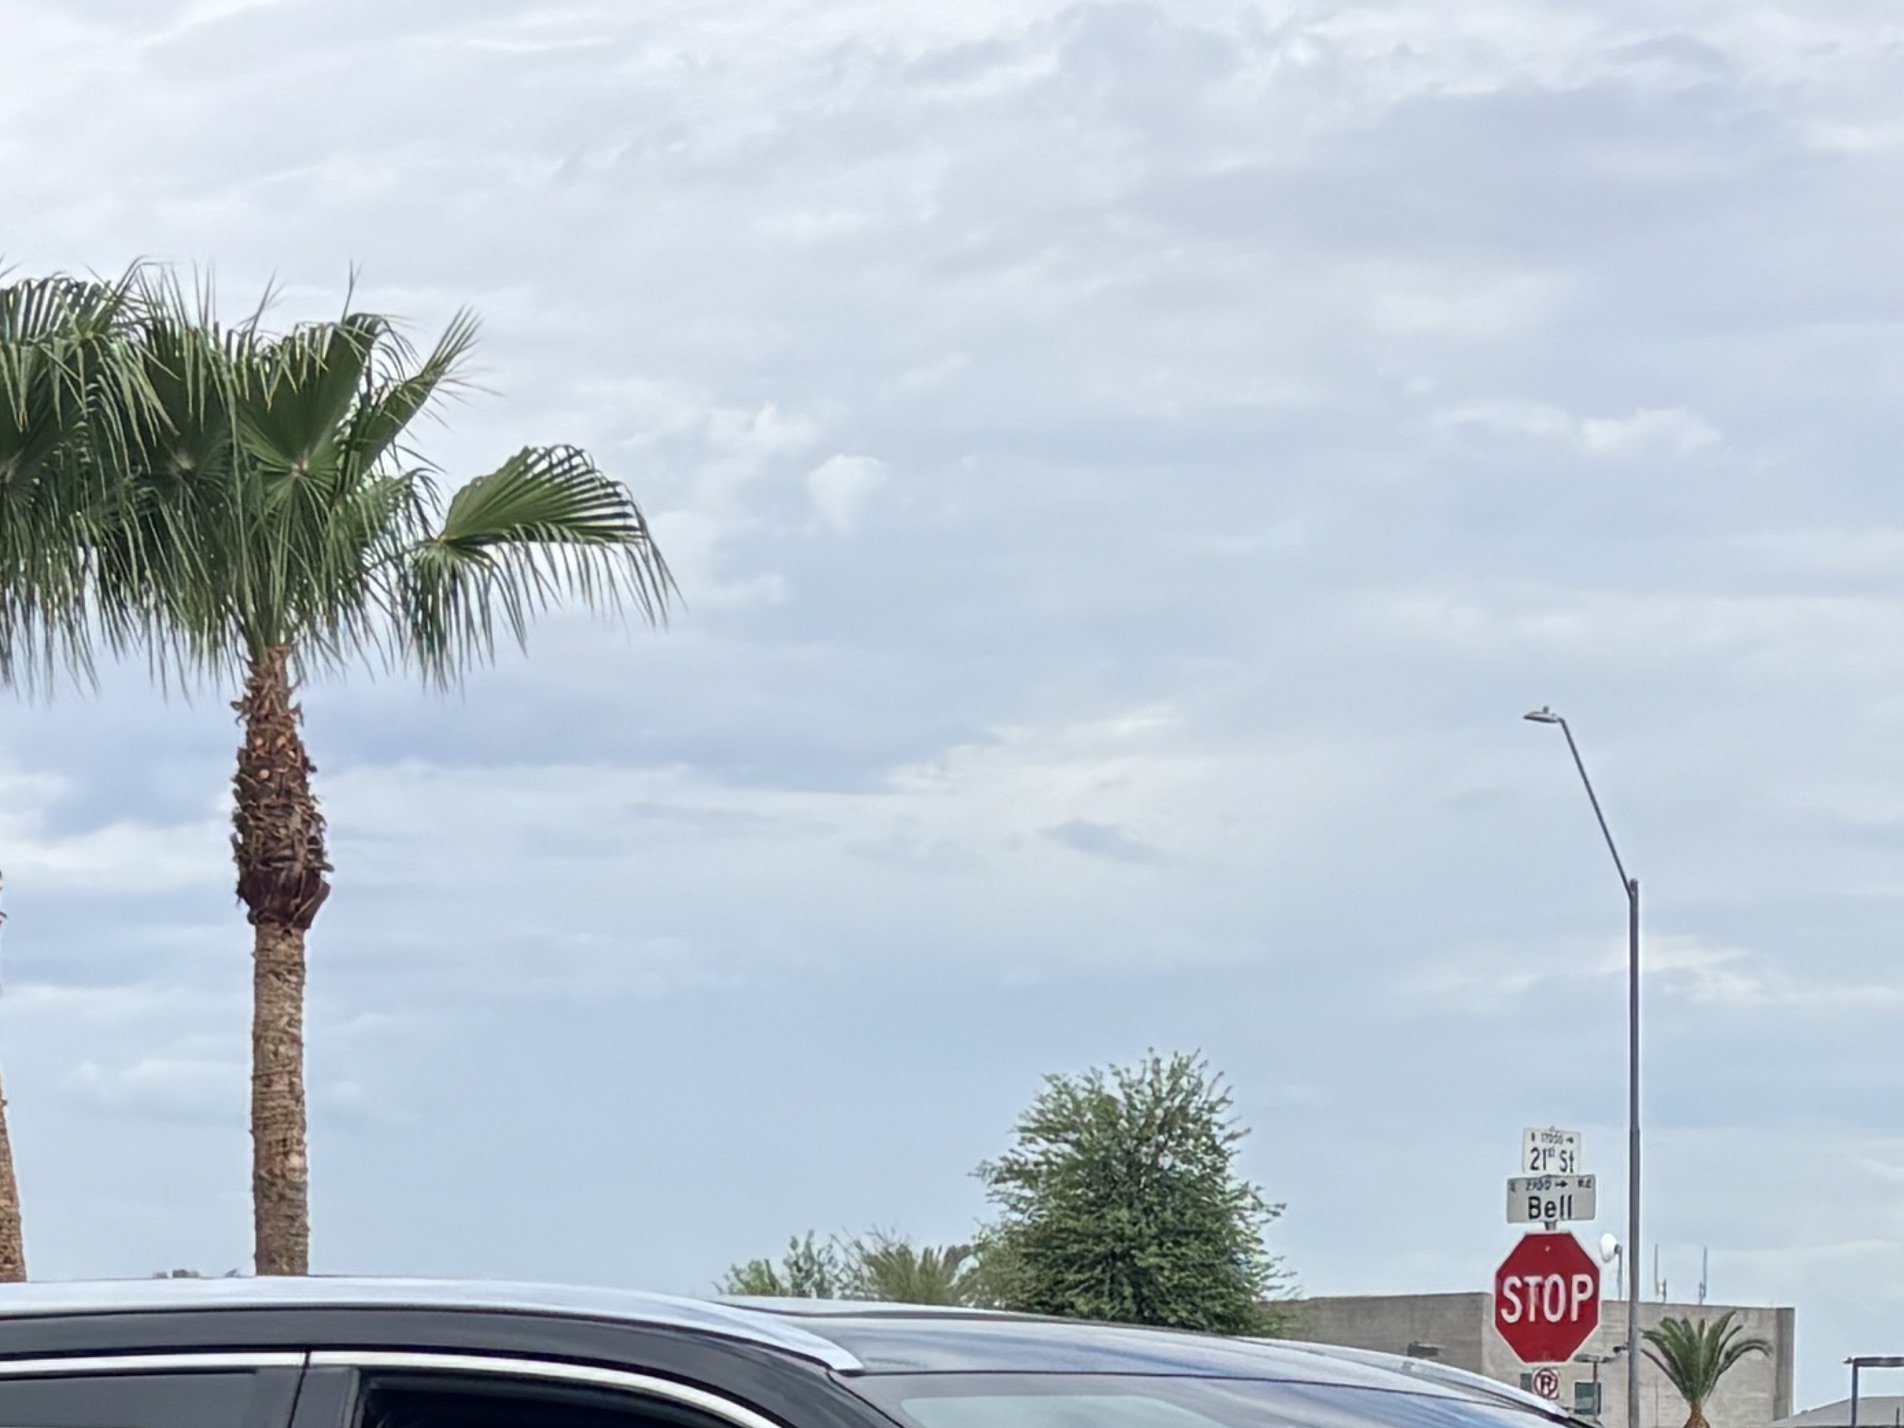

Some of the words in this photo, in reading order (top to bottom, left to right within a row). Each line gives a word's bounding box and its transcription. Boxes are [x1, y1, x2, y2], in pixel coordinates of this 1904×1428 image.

[1559, 1149, 1575, 1173] St
[1528, 1194, 1573, 1220] Bell
[1500, 1273, 1594, 1323] STOP
